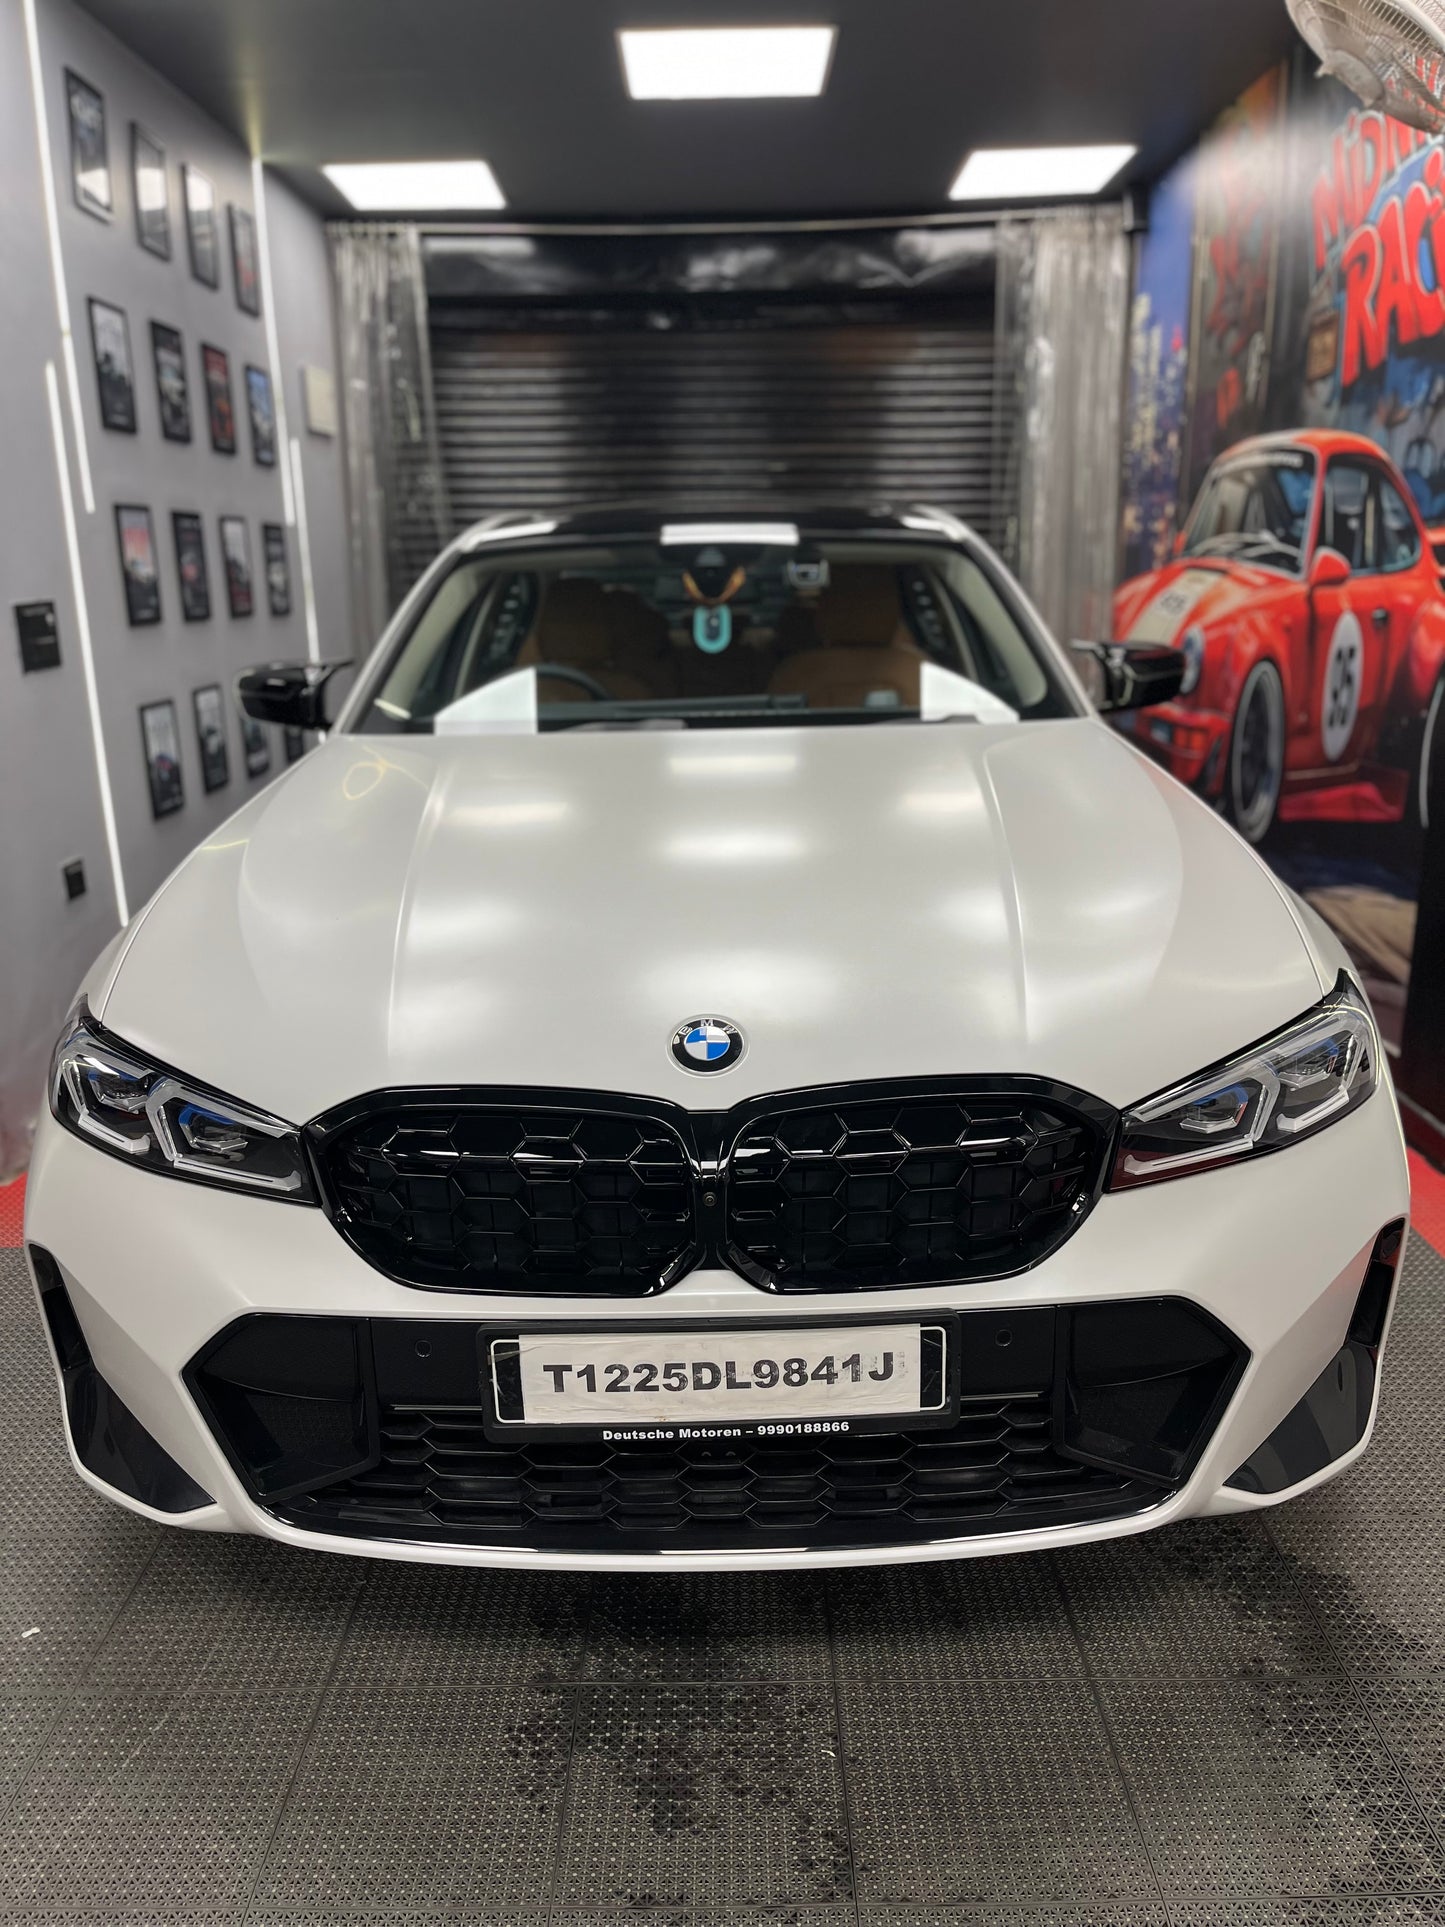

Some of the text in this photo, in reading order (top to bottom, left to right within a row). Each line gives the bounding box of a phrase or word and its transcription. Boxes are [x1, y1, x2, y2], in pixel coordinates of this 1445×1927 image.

[678, 1018, 738, 1036] BMW
[542, 1351, 894, 1393] T1225DL9841J
[602, 1429, 675, 1440] Deutsche
[679, 1427, 742, 1439] Motoren
[757, 1421, 850, 1436] 9990188866
